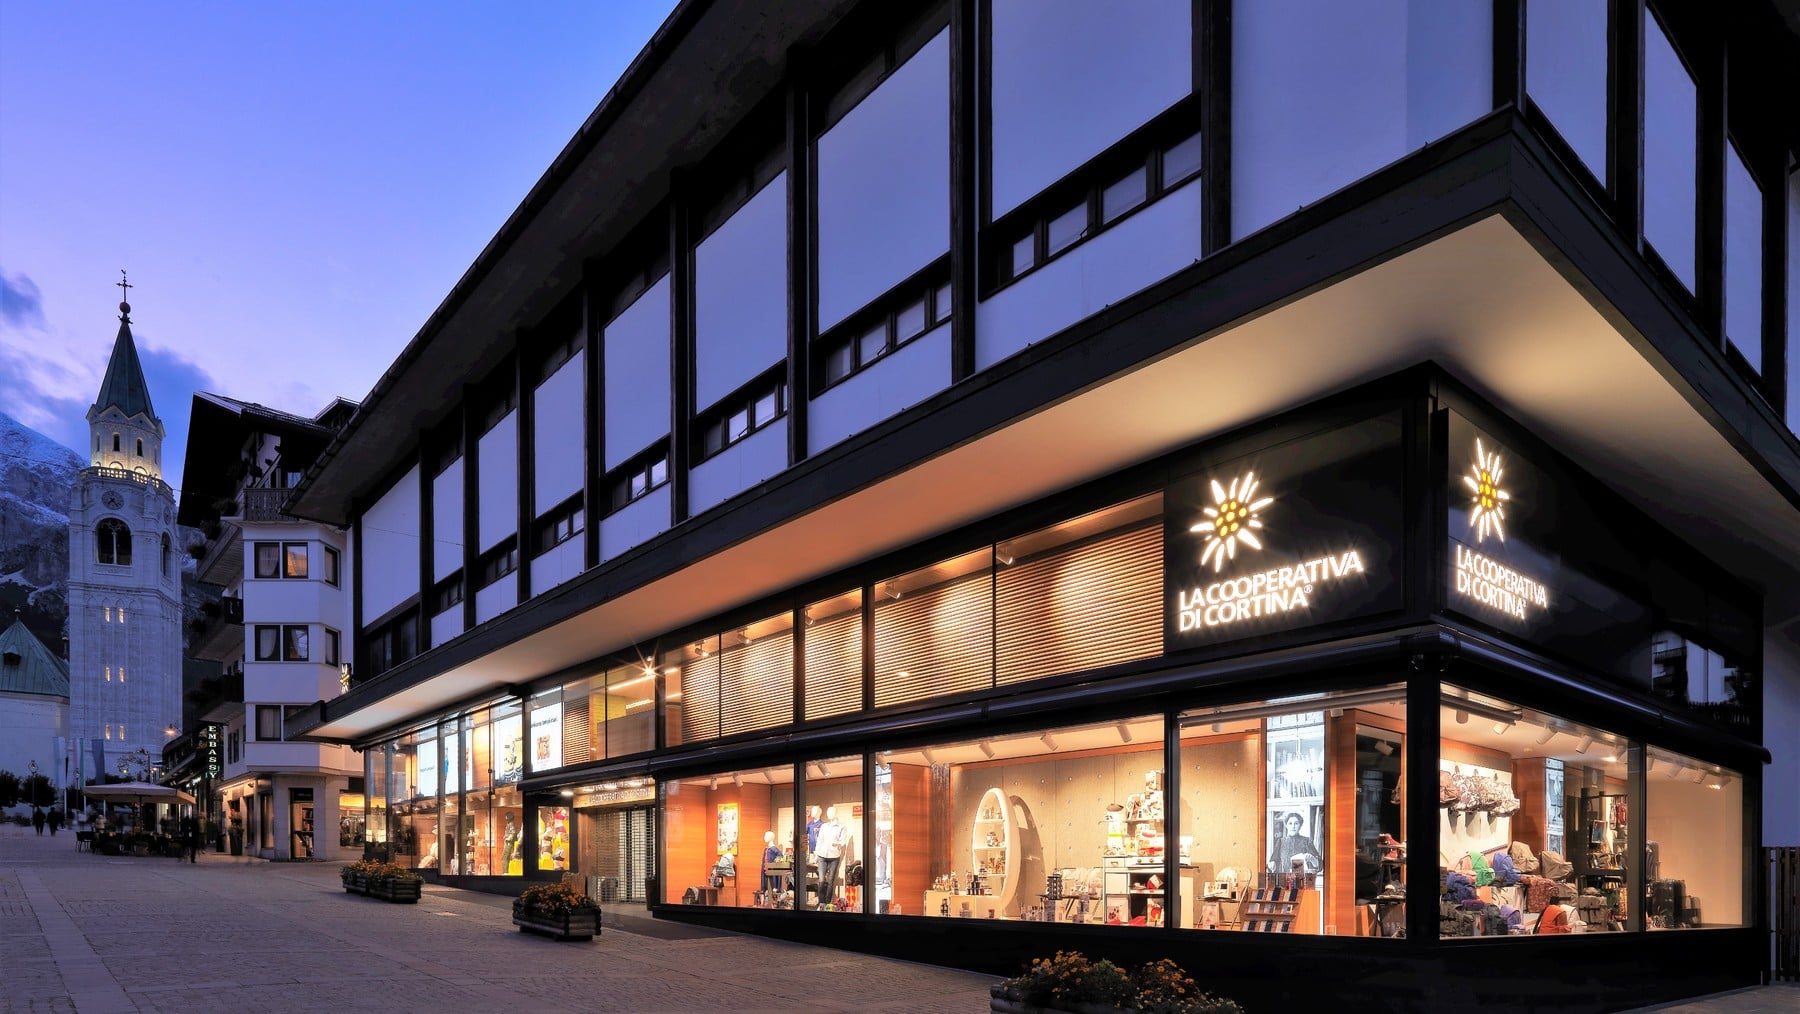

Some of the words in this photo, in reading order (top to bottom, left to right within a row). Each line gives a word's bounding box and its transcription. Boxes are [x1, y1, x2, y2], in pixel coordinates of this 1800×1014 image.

[1179, 588, 1206, 611] LA
[1206, 550, 1365, 605] COOPERATIVA
[1457, 543, 1474, 573] LA
[1473, 554, 1547, 609] COOPERATIVA
[1457, 568, 1471, 596] DI
[1179, 608, 1201, 632] DI
[208, 725, 217, 779] EMBASSY
